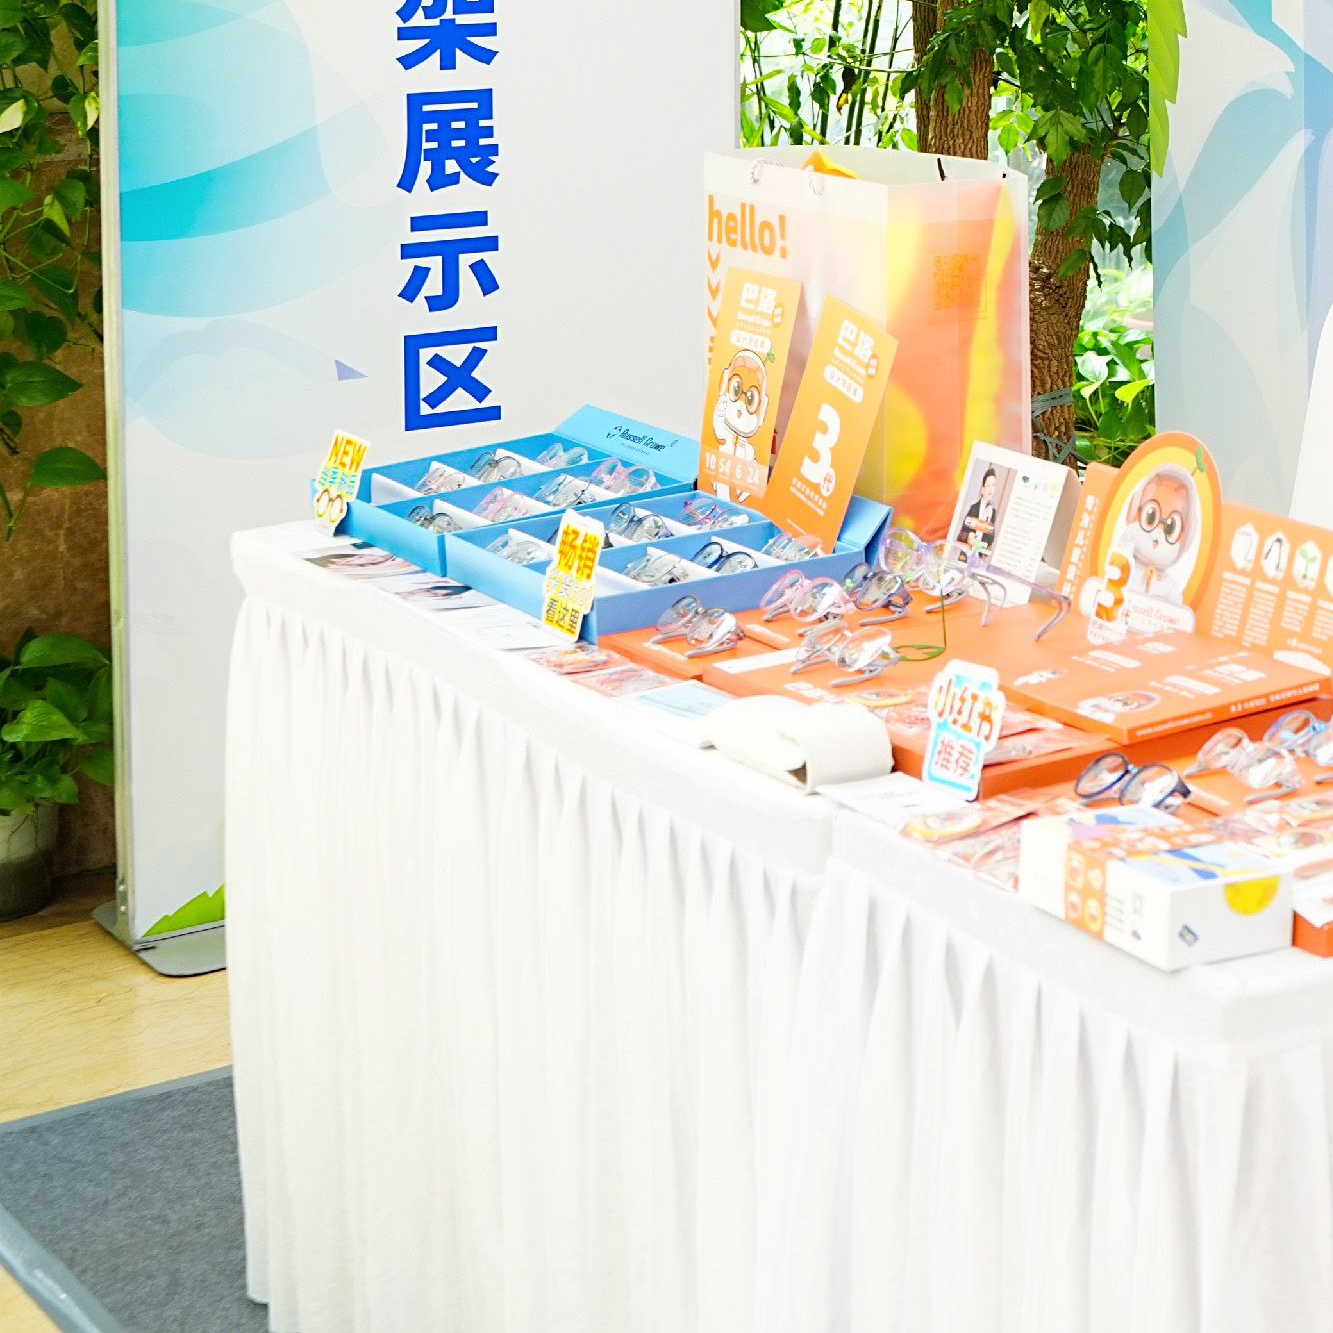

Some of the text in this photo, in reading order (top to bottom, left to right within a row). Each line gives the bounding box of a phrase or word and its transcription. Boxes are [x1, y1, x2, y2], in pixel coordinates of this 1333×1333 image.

[708, 194, 788, 259] hello!
[329, 434, 367, 473] NEW
[800, 402, 841, 484] 3
[558, 524, 600, 580] 畅销
[934, 677, 999, 744] 小红书
[936, 735, 976, 779] 推荐
